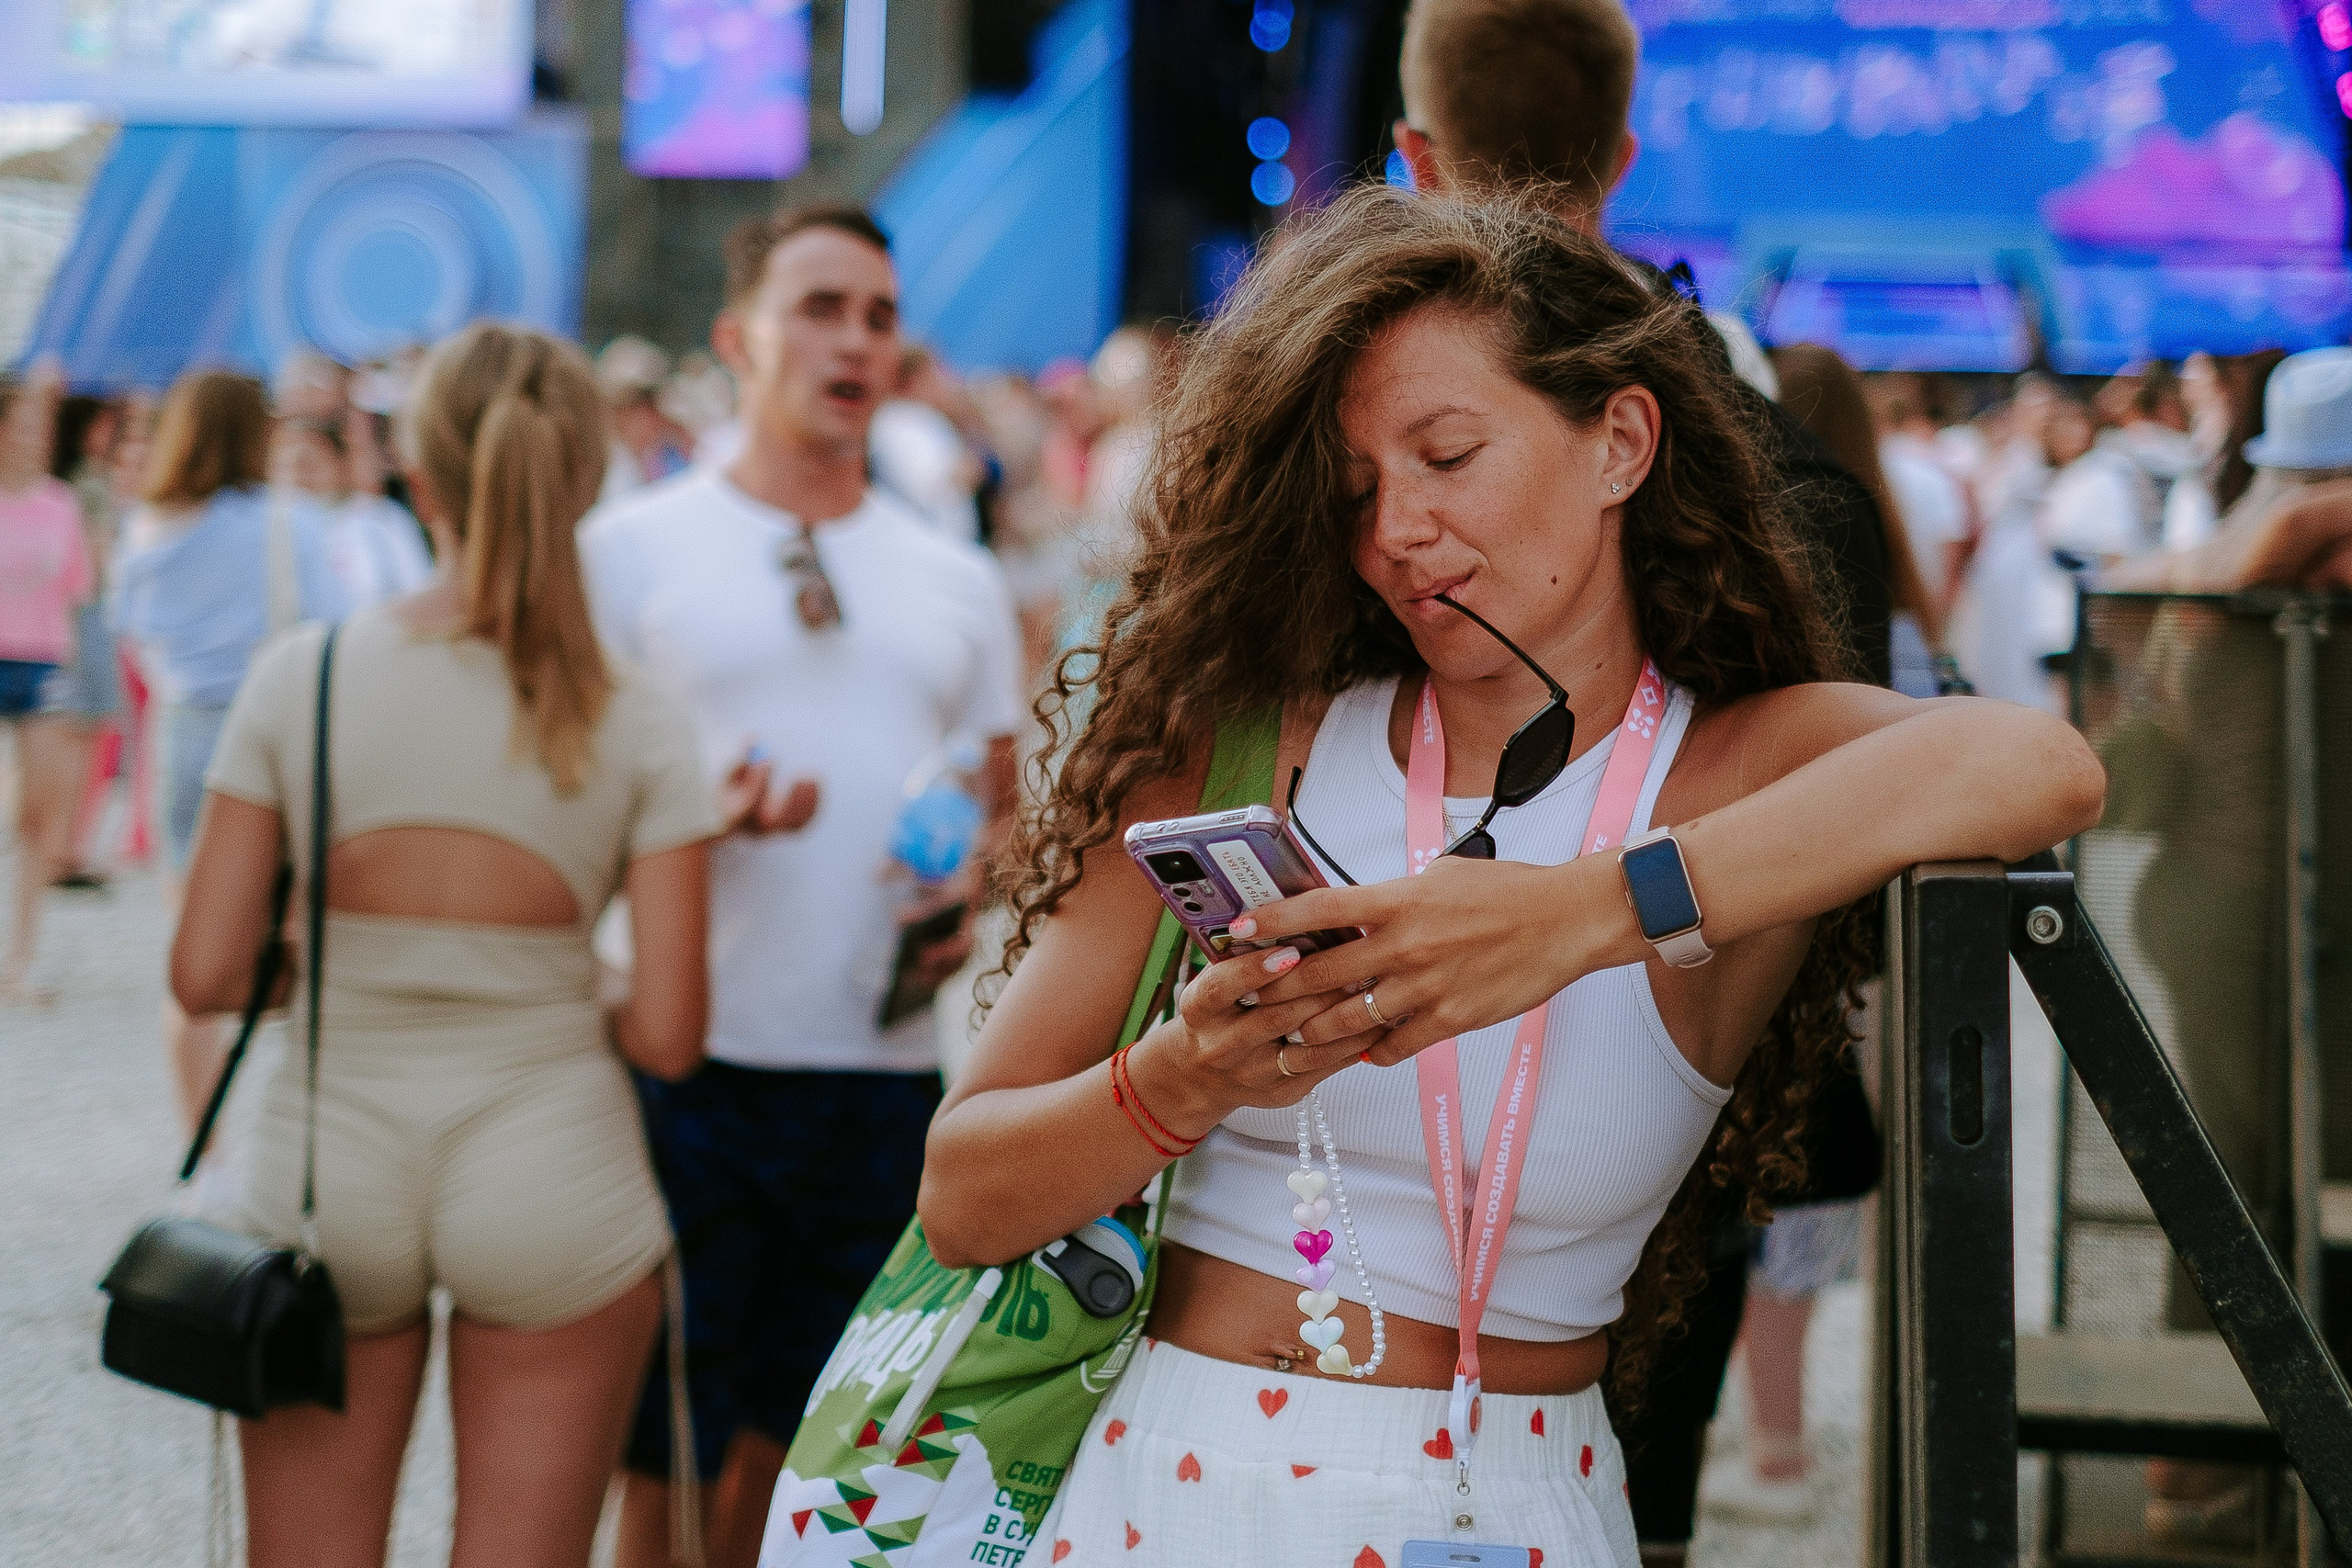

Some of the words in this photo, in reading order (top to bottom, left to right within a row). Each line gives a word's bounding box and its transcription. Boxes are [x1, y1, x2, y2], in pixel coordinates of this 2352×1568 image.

[1221, 851, 1239, 871] ЕБАТЬ
[1237, 856, 1263, 886] ДОЛЖНО
[1235, 872, 1249, 884] ЭТО
[1244, 886, 1261, 903] ТЕБЯ
[1435, 1093, 1453, 1171] УЧИМСЯ
[1470, 1228, 1495, 1303] УЧИМСЯ
[1485, 1118, 1515, 1225] СОЗДАВАТЬ
[1507, 1043, 1532, 1115] ВМЕСТЕ
[982, 1513, 1001, 1535] В
